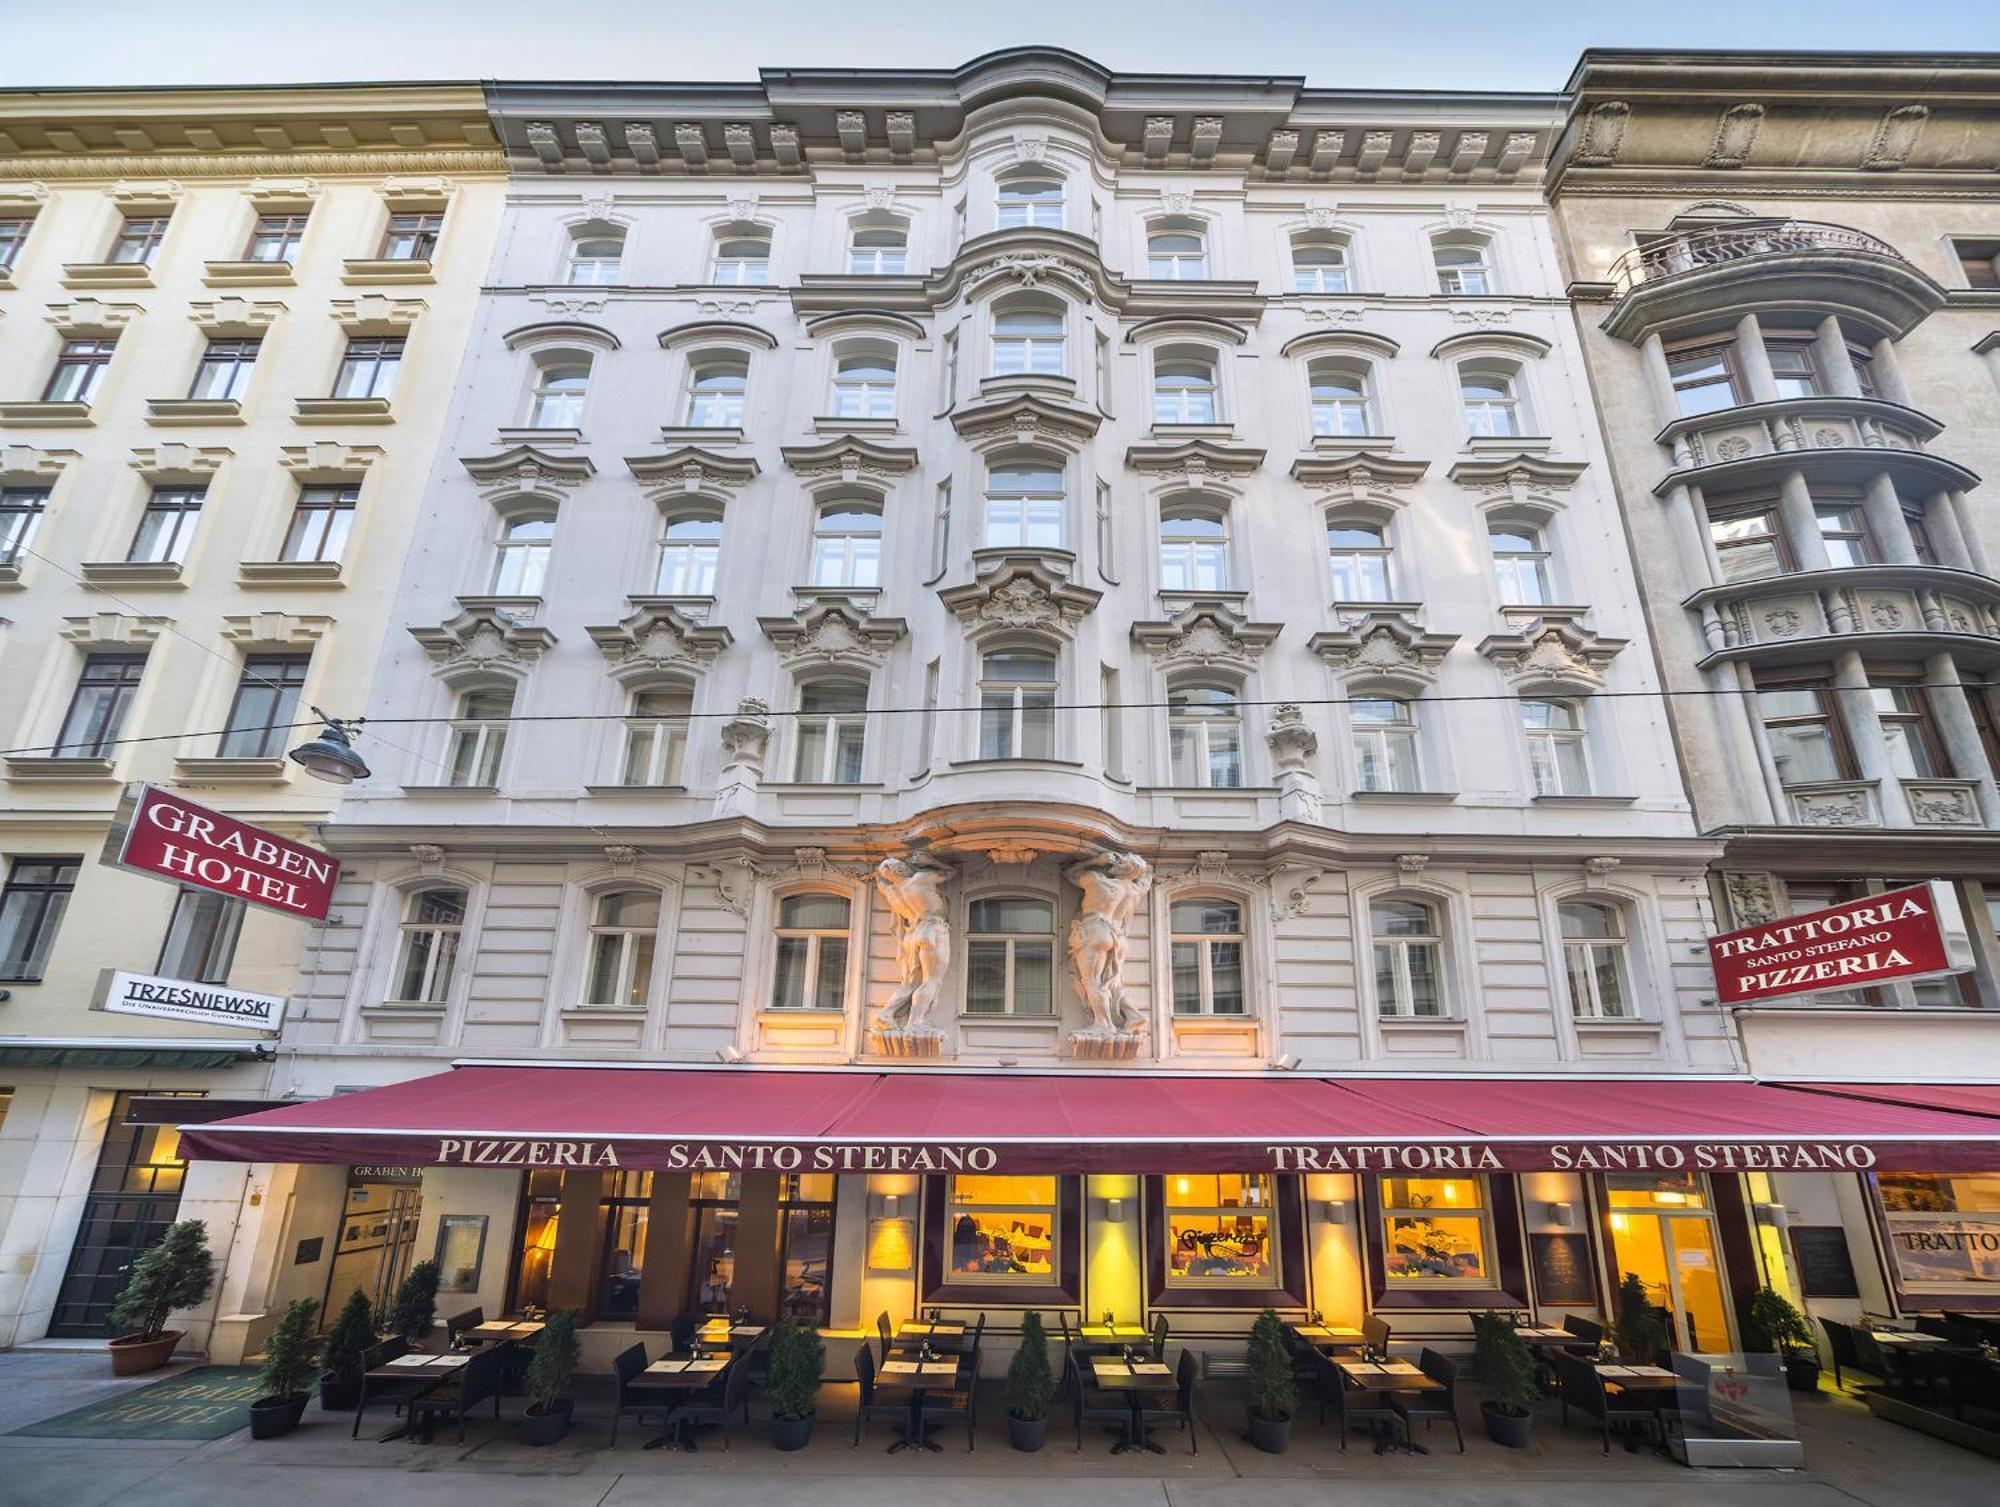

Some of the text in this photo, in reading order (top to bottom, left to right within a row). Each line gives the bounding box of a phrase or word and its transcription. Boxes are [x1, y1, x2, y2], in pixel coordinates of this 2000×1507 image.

[148, 803, 333, 885] GRABEN
[157, 842, 308, 909] HOTEL
[1715, 898, 1928, 958] TRATTORIA
[1747, 931, 1892, 968] SANTO STEFANO
[1737, 949, 1913, 993] PIZZERIA
[124, 981, 271, 1018] TRZEŚNIEWSKI
[354, 1166, 408, 1176] GRABEN
[435, 1139, 1876, 1171] PIZZERIA SANTO STEFANO TRATTORIA SANTO STEFANO
[1903, 1232, 2000, 1251] TRATTO
